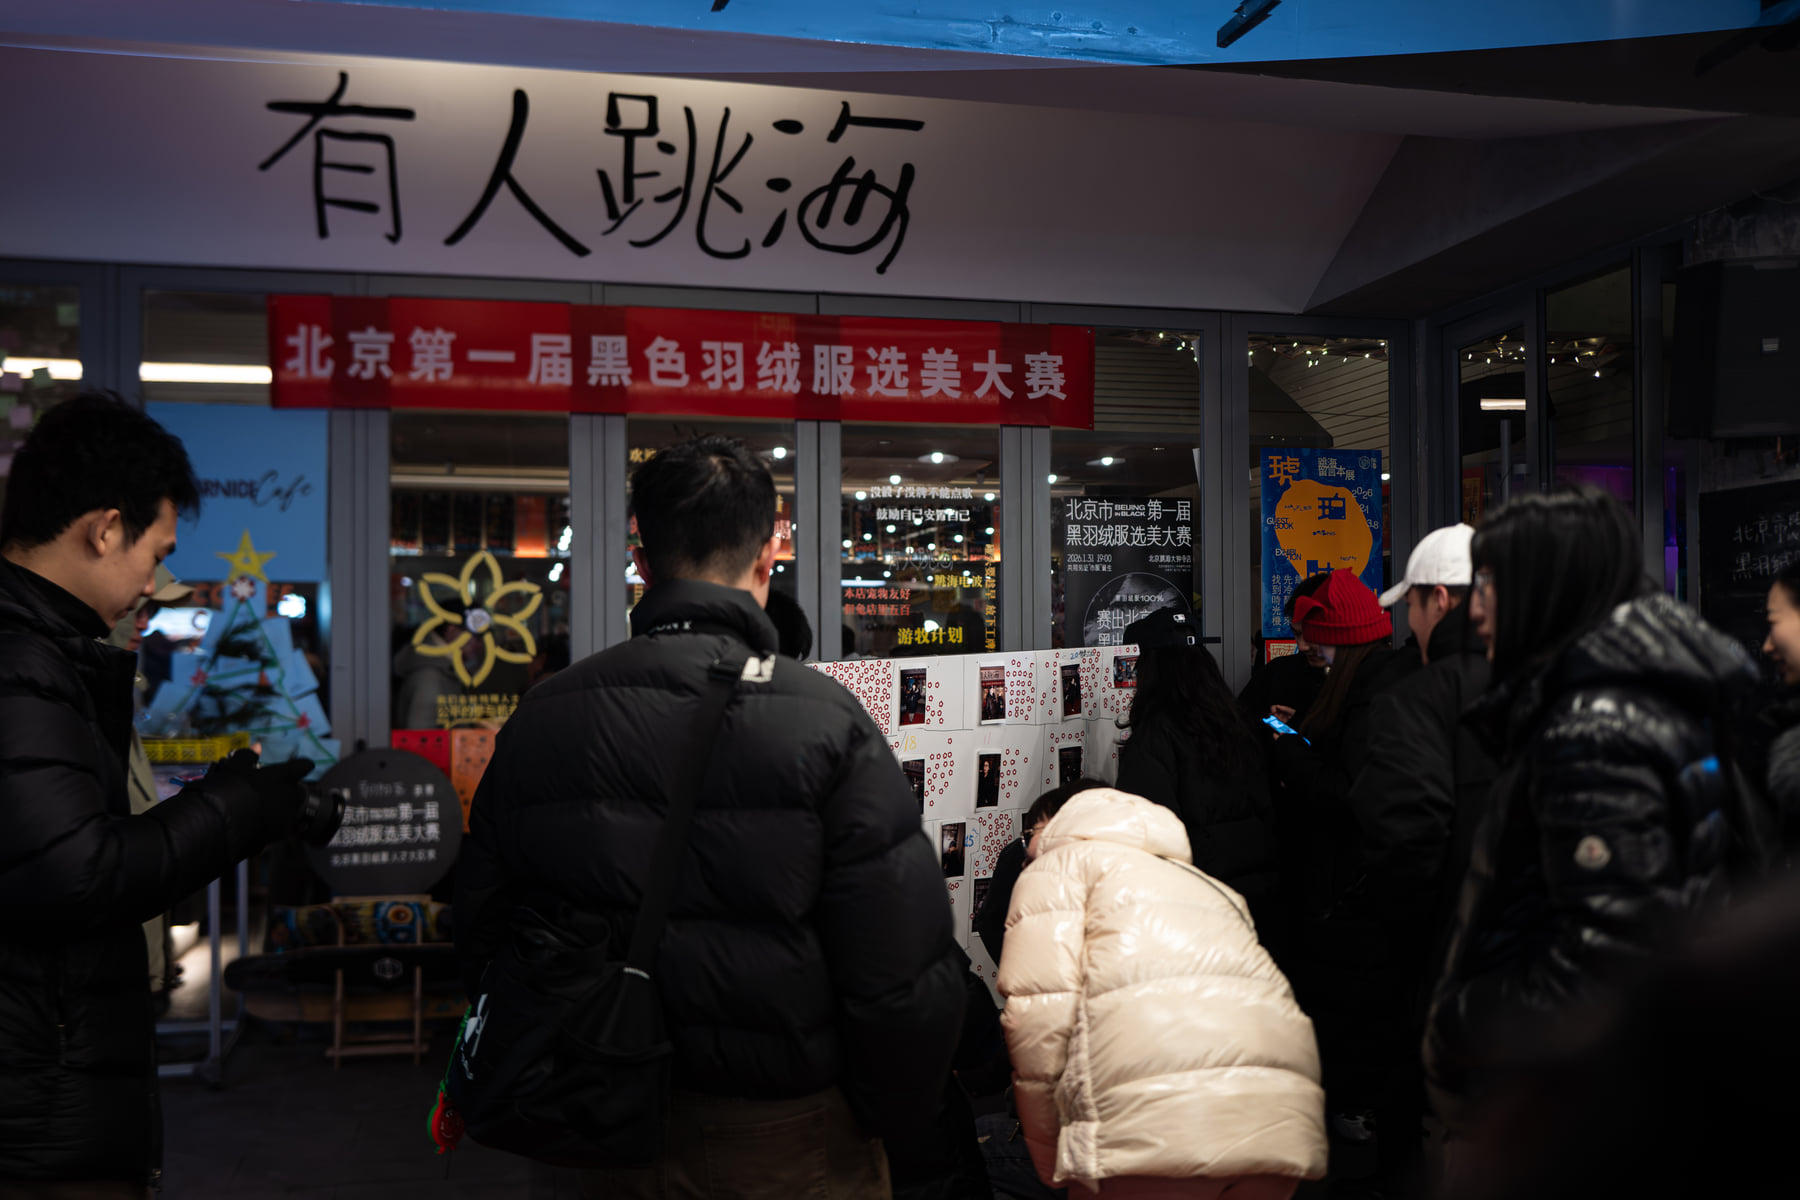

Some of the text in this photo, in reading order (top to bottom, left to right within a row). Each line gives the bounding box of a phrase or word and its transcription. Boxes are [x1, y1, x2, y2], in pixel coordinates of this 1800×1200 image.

[259, 72, 924, 274] 有人跳海
[284, 322, 1068, 401] 北京第一届黑色羽绒服选美大赛
[1352, 486, 1373, 499] 2026
[1066, 498, 1191, 521] 北京市 第一届
[1066, 525, 1193, 547] 黑羽绒服选美大赛
[934, 574, 983, 588] 跳海电波
[844, 587, 911, 600] 本店宠物友好
[898, 626, 963, 645] 游牧计划
[398, 801, 440, 822] 第一届
